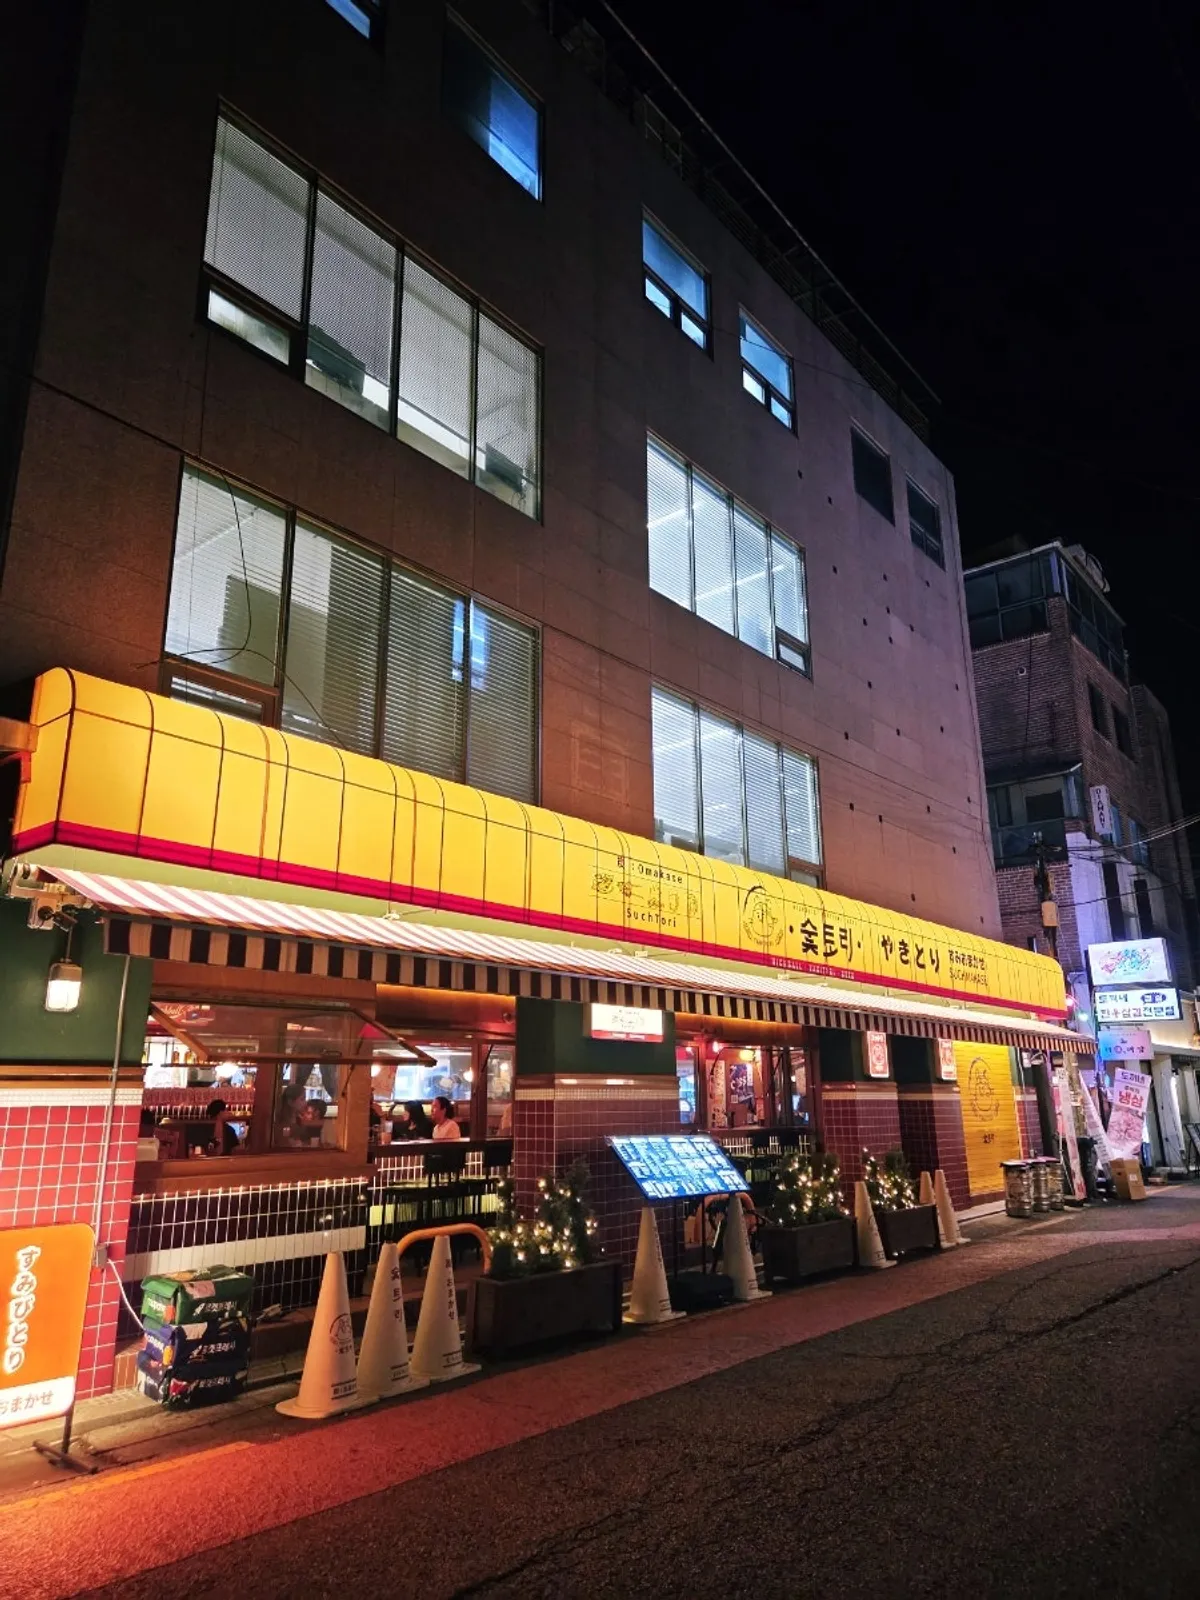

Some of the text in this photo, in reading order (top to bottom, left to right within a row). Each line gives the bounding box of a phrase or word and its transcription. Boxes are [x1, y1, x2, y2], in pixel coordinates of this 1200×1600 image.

[626, 907, 677, 928] SuchTori
[880, 934, 940, 973] やきとり
[6, 1247, 40, 1372] すみびとり
